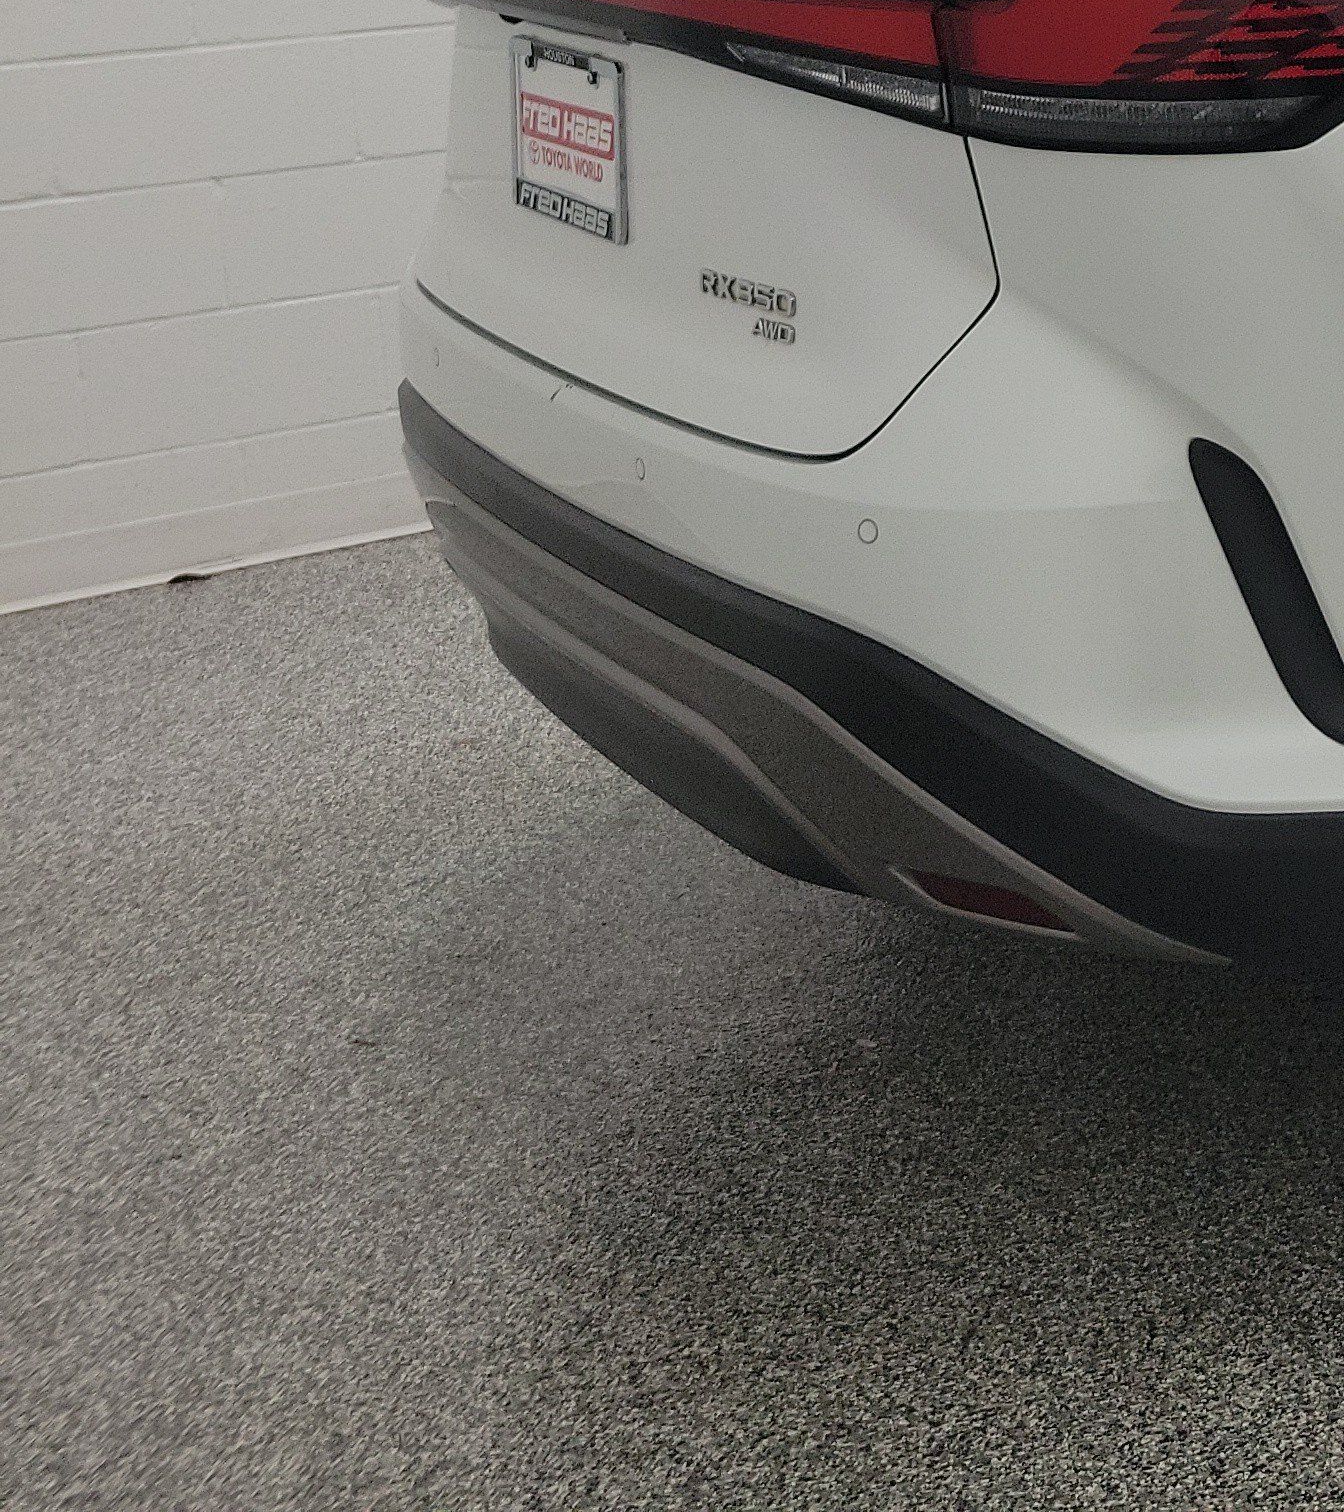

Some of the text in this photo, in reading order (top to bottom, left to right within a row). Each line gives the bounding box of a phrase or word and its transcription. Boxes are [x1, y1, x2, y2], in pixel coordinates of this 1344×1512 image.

[544, 48, 576, 66] HOUSTON
[542, 145, 604, 182] TOYOTA WORLD
[702, 268, 797, 318] RX350
[753, 317, 796, 345] AWD
